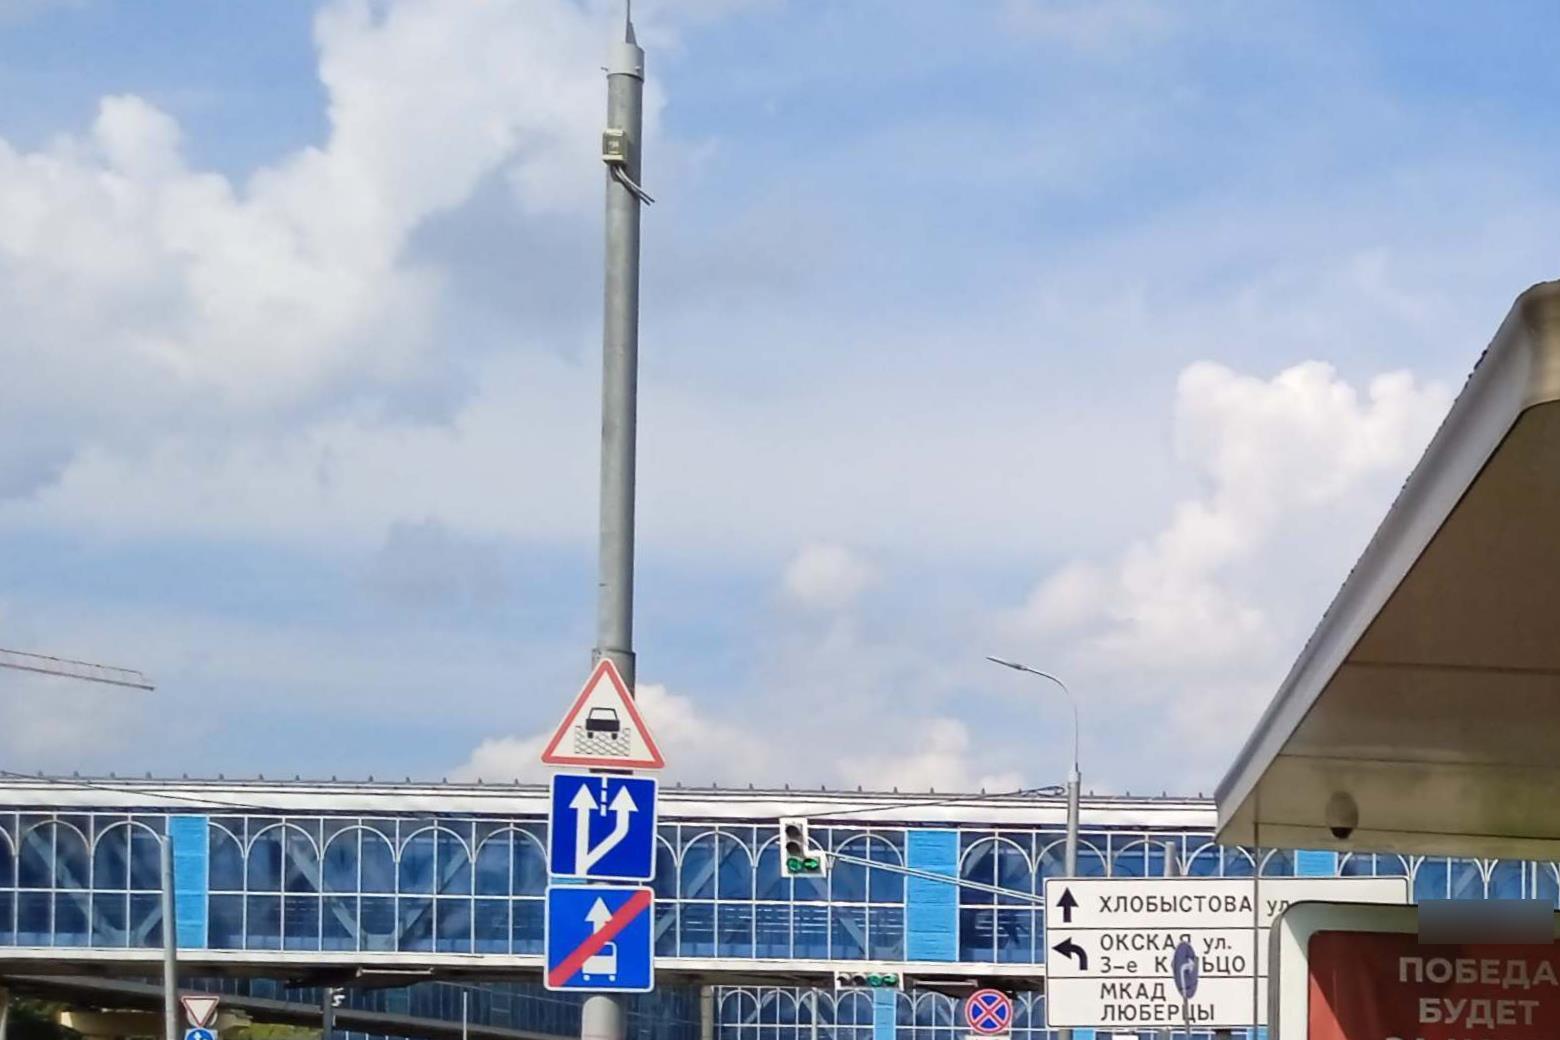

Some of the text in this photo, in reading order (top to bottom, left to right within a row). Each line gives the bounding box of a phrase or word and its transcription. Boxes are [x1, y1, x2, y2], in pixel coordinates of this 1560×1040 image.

[1099, 895, 1252, 913] ХЛОБЫСТОВА
[1203, 937, 1233, 955] ул.
[1155, 955, 1247, 976] КЬЦО
[1399, 956, 1559, 990] ПОБЕДА
[1100, 982, 1167, 1002] МКАД
[1101, 1003, 1214, 1023] ЛЮБЕРЦЫ
[1418, 997, 1540, 1029] БУДЕТ
